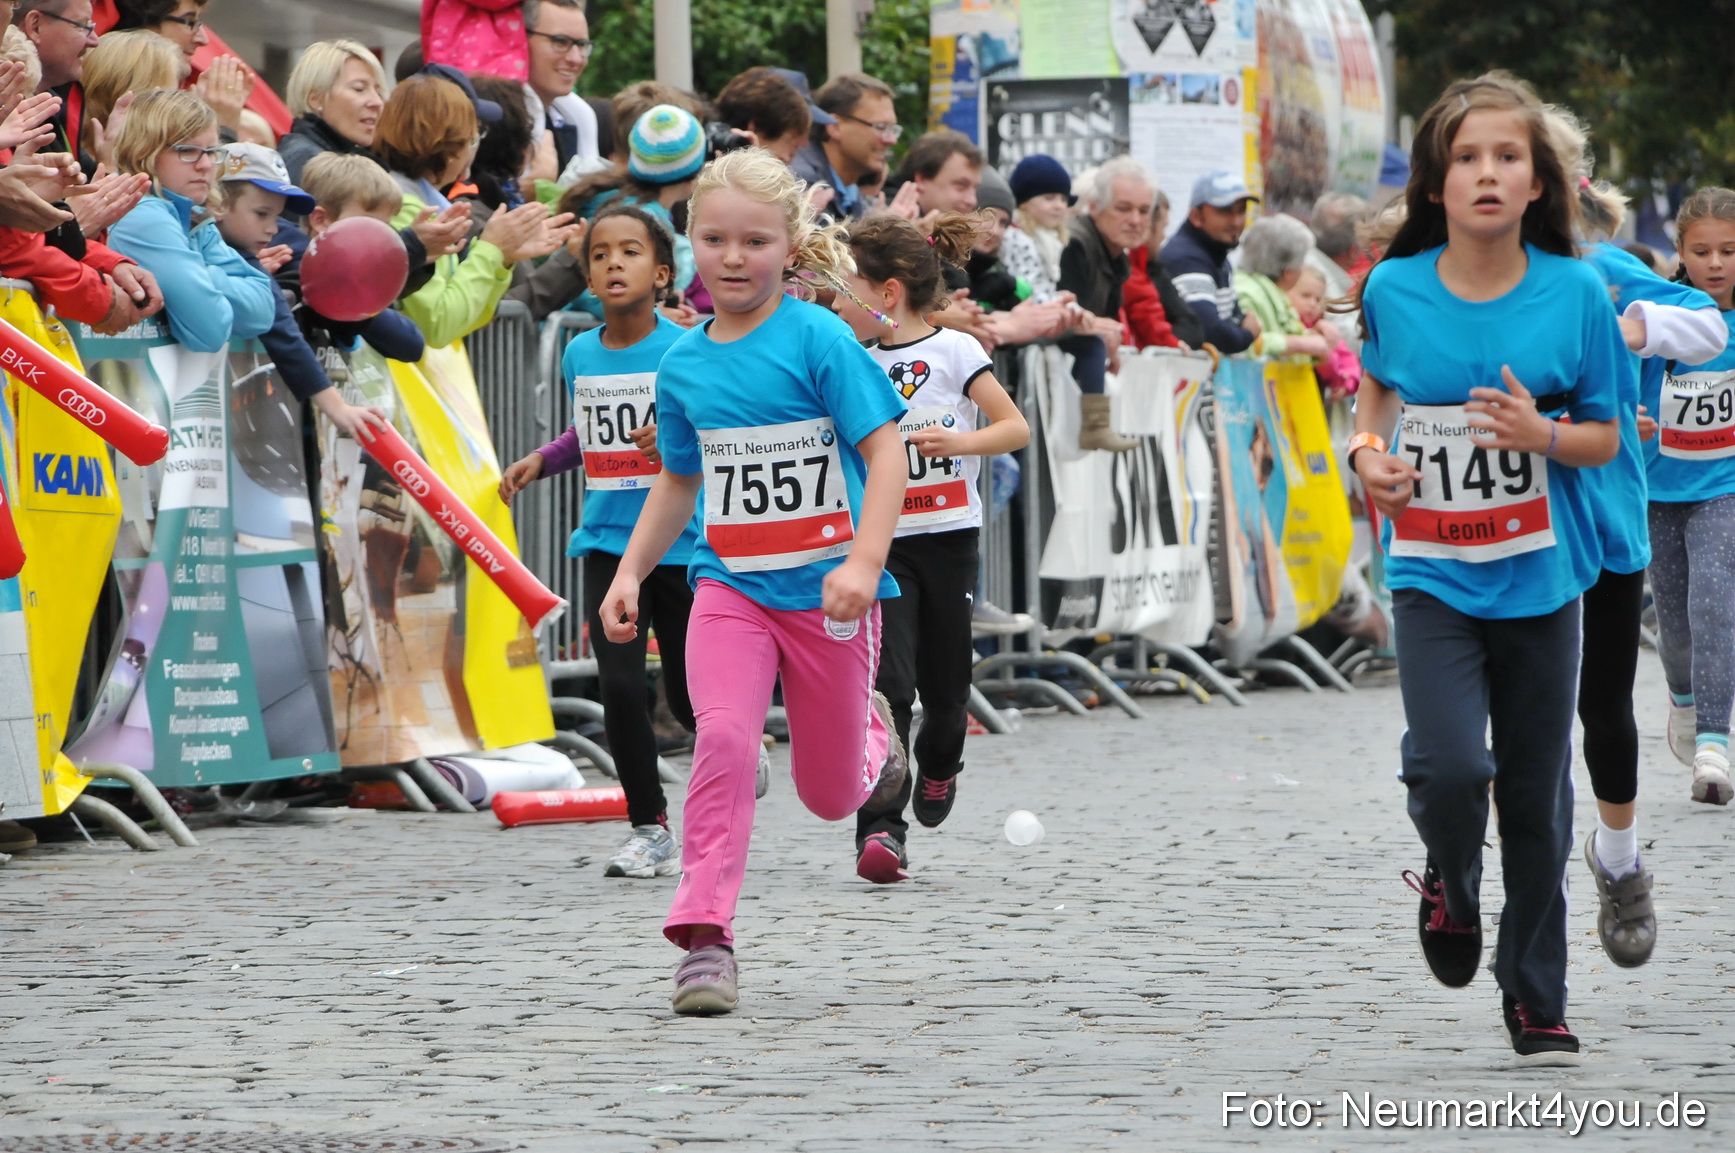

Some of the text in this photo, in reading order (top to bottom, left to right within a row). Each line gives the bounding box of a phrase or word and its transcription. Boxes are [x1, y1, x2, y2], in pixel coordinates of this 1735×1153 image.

[997, 111, 1116, 141] GLENN
[0, 347, 46, 384] BKK
[597, 385, 651, 398] Neumarkt
[1665, 377, 1701, 390] PARTL
[1673, 388, 1735, 426] 759
[703, 436, 817, 457] PARTL Neumarkt
[592, 454, 639, 473] Victoria
[1404, 443, 1533, 502] 7149
[714, 454, 830, 516] 7557
[903, 494, 934, 511] ena
[435, 503, 506, 574] Audi BKK
[1437, 516, 1497, 540] Leoni
